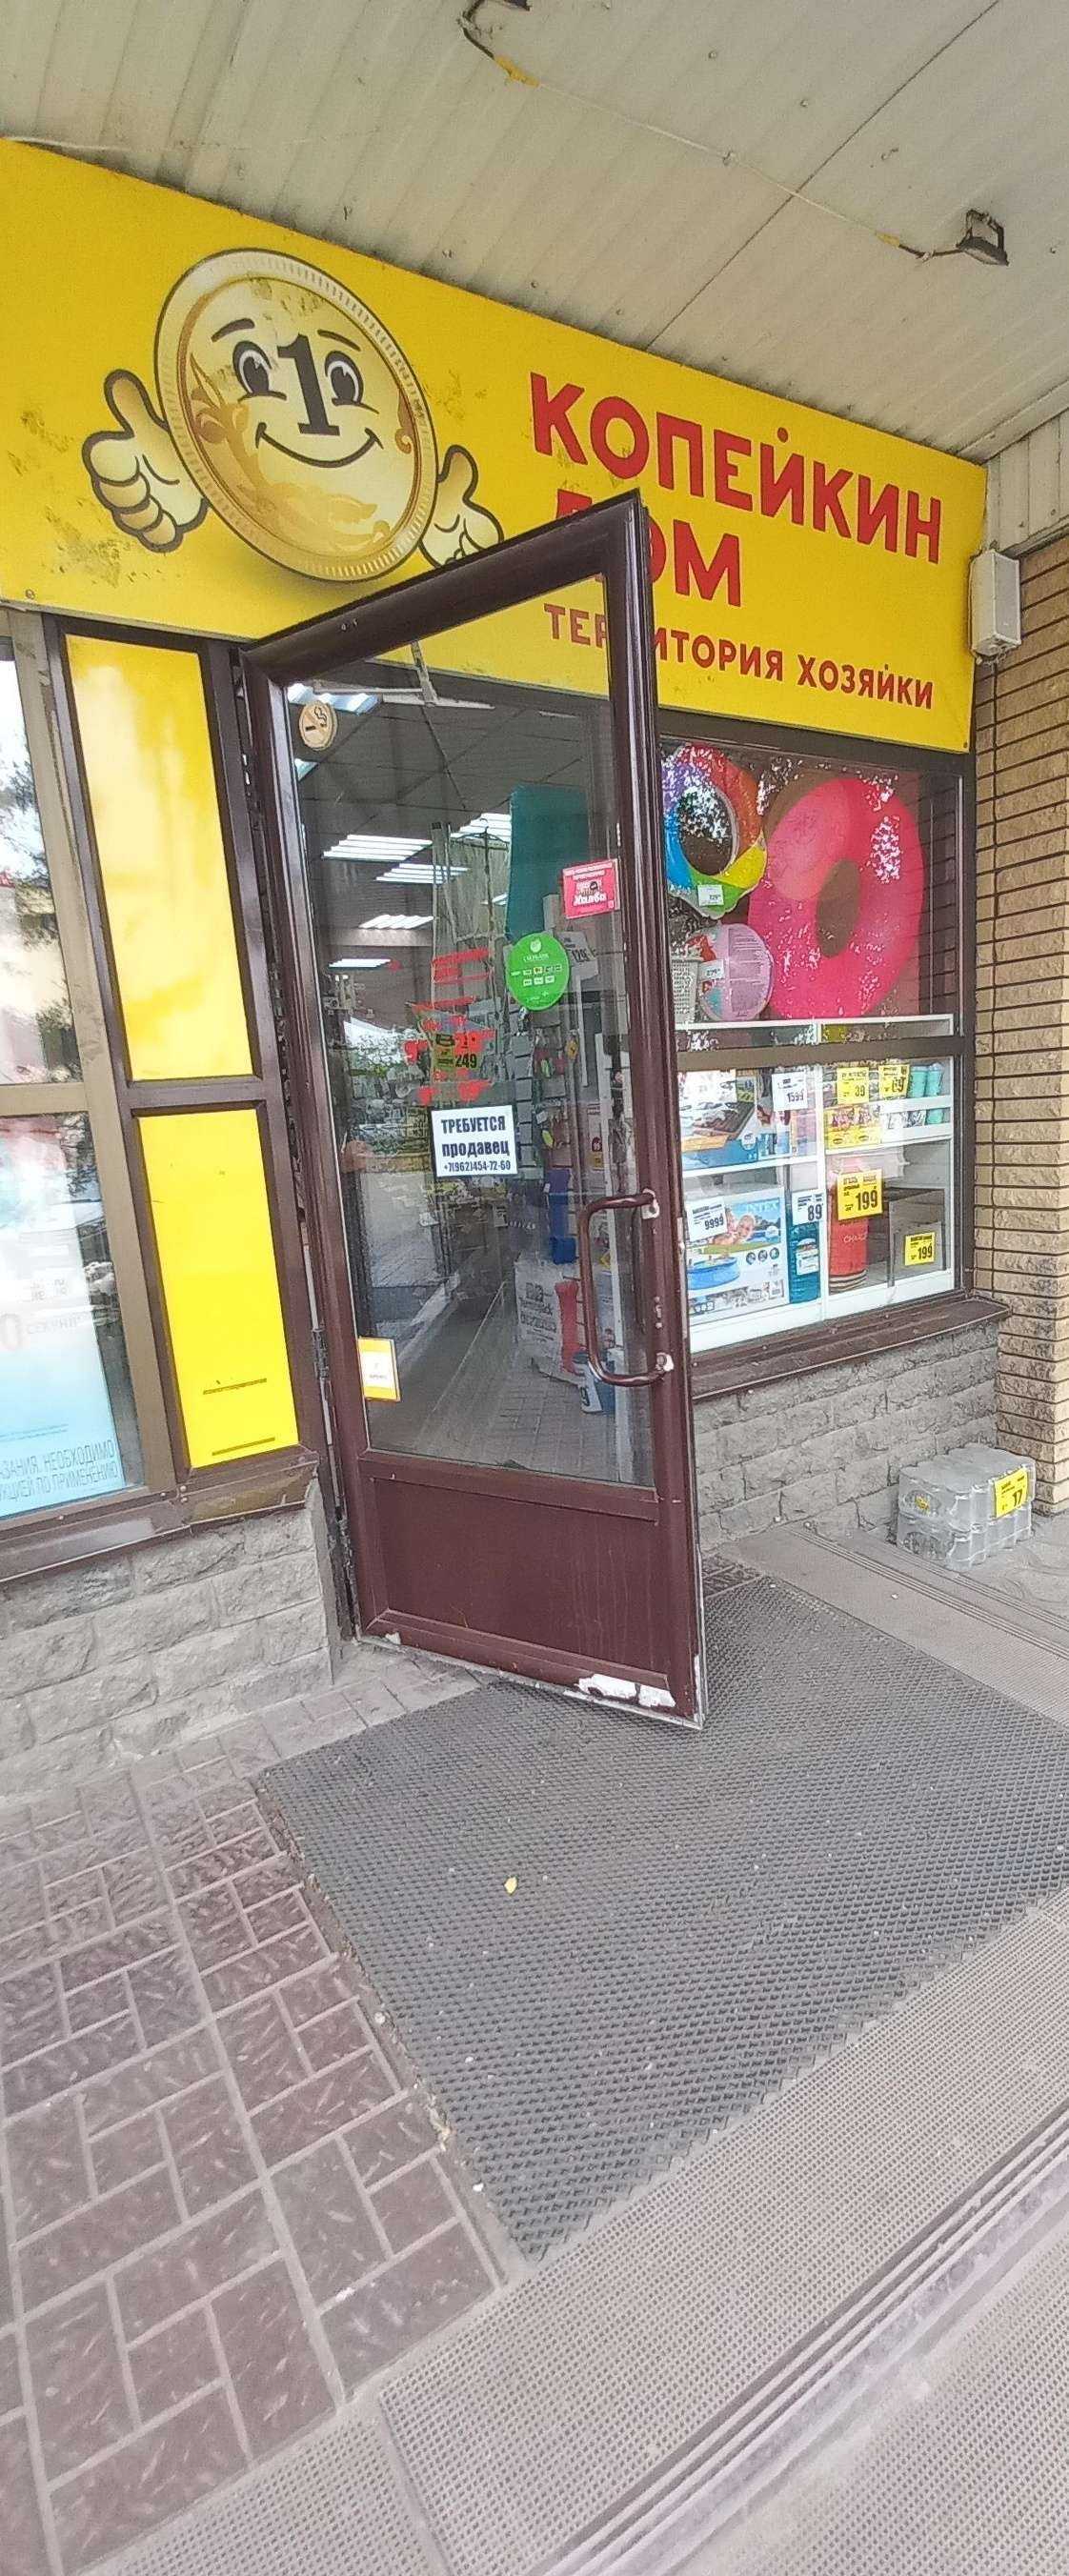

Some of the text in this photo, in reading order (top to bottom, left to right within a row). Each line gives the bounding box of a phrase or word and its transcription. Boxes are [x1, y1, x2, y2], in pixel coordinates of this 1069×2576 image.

[276, 333, 340, 436] 1
[530, 371, 942, 565] КОПЕЙКИН
[543, 602, 934, 710] ТЕРИТОРИЯ ХОЗЯЙКИ
[454, 1053, 477, 1069] 249
[787, 1089, 804, 1102] 1599
[855, 1085, 866, 1097] 39
[441, 1116, 506, 1134] ТРЕБУЕТСЯ
[442, 1140, 510, 1158] продавец
[444, 1159, 511, 1172] +7(962)454-72-60
[856, 1189, 878, 1211] 199
[808, 1203, 822, 1221] 89
[704, 1216, 724, 1230] 9999
[918, 1243, 933, 1259] 199
[44, 1439, 114, 1473] НЕОБХОДИМО
[1012, 1489, 1023, 1507] 17
